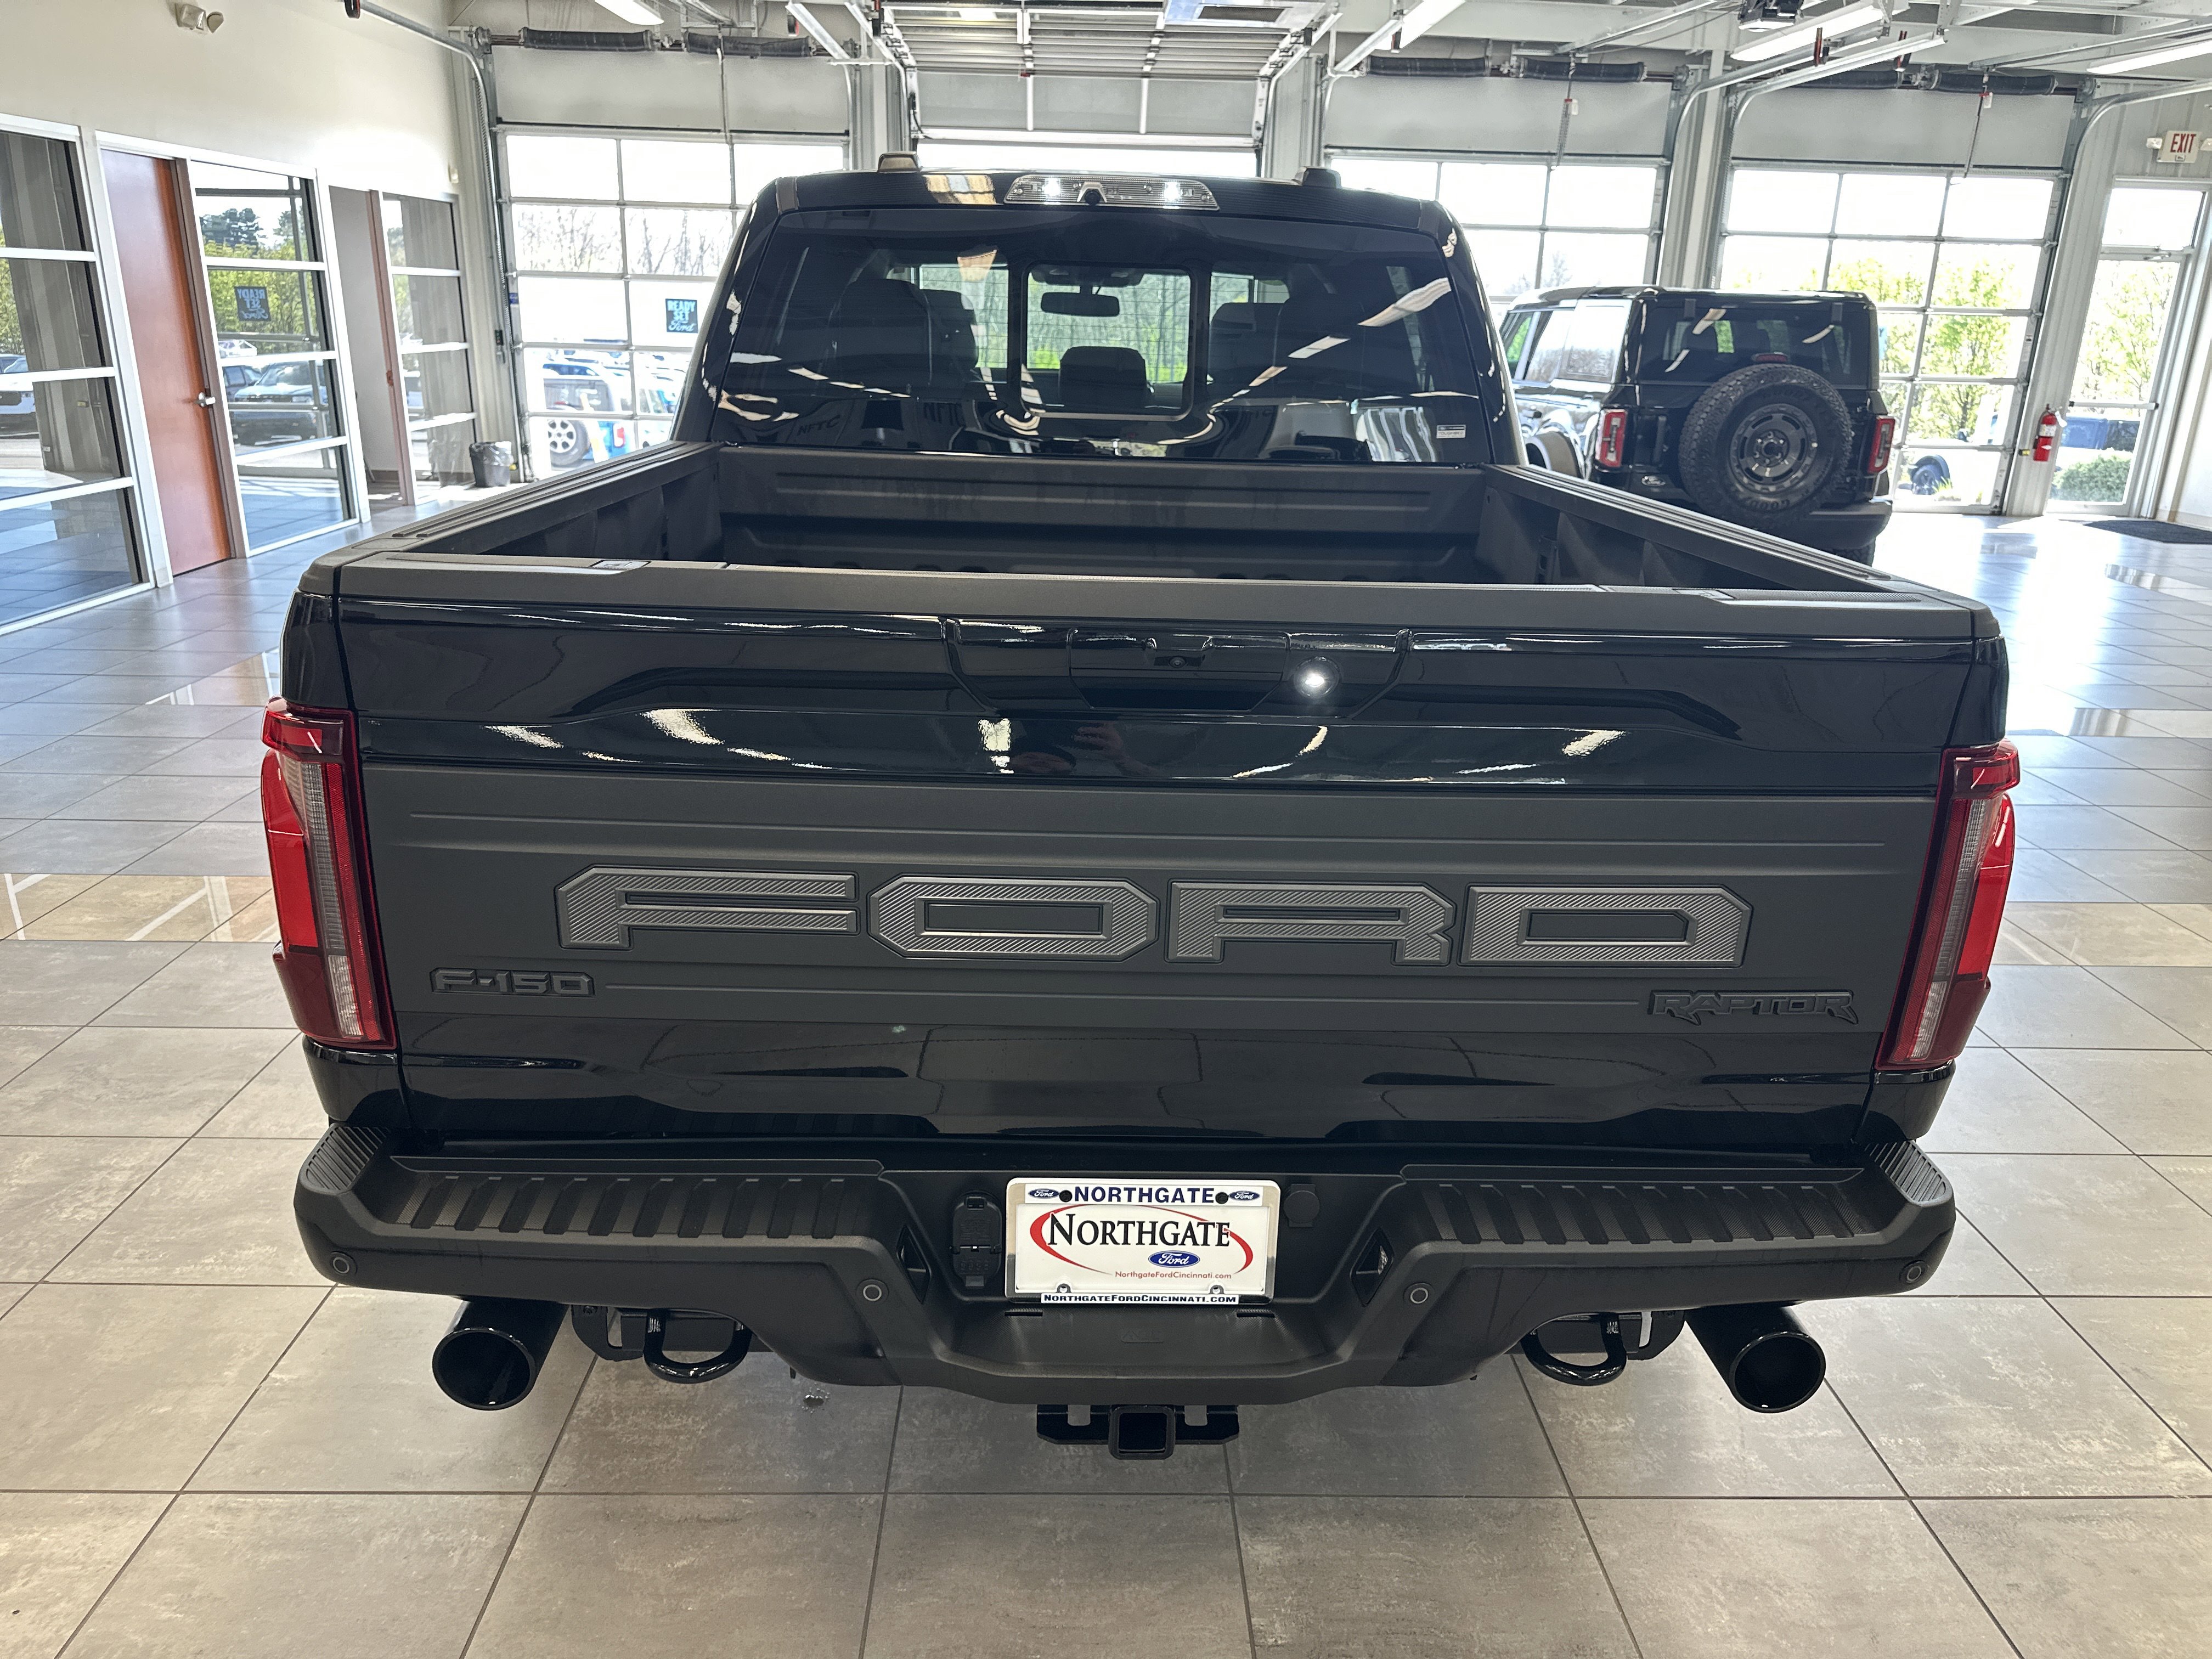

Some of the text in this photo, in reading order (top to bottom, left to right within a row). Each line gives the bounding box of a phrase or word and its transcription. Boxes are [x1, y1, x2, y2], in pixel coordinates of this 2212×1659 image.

[2170, 133, 2197, 154] EXIT
[668, 300, 696, 312] READY
[673, 311, 690, 321] SET
[668, 320, 697, 331] Ford
[556, 866, 1753, 967] FORD
[432, 968, 593, 996] F-150
[1649, 990, 1859, 1025] RAPTOR
[1033, 1186, 1254, 1203] Ford NORTHGATE Ford
[1047, 1212, 1230, 1247] NORTHGATE
[1157, 1251, 1190, 1266] Ford
[1115, 1271, 1232, 1279] NorthgateFordCincinnati.com
[1044, 1294, 1237, 1303] NORTHGATEFORDCINCINNATI.COM
